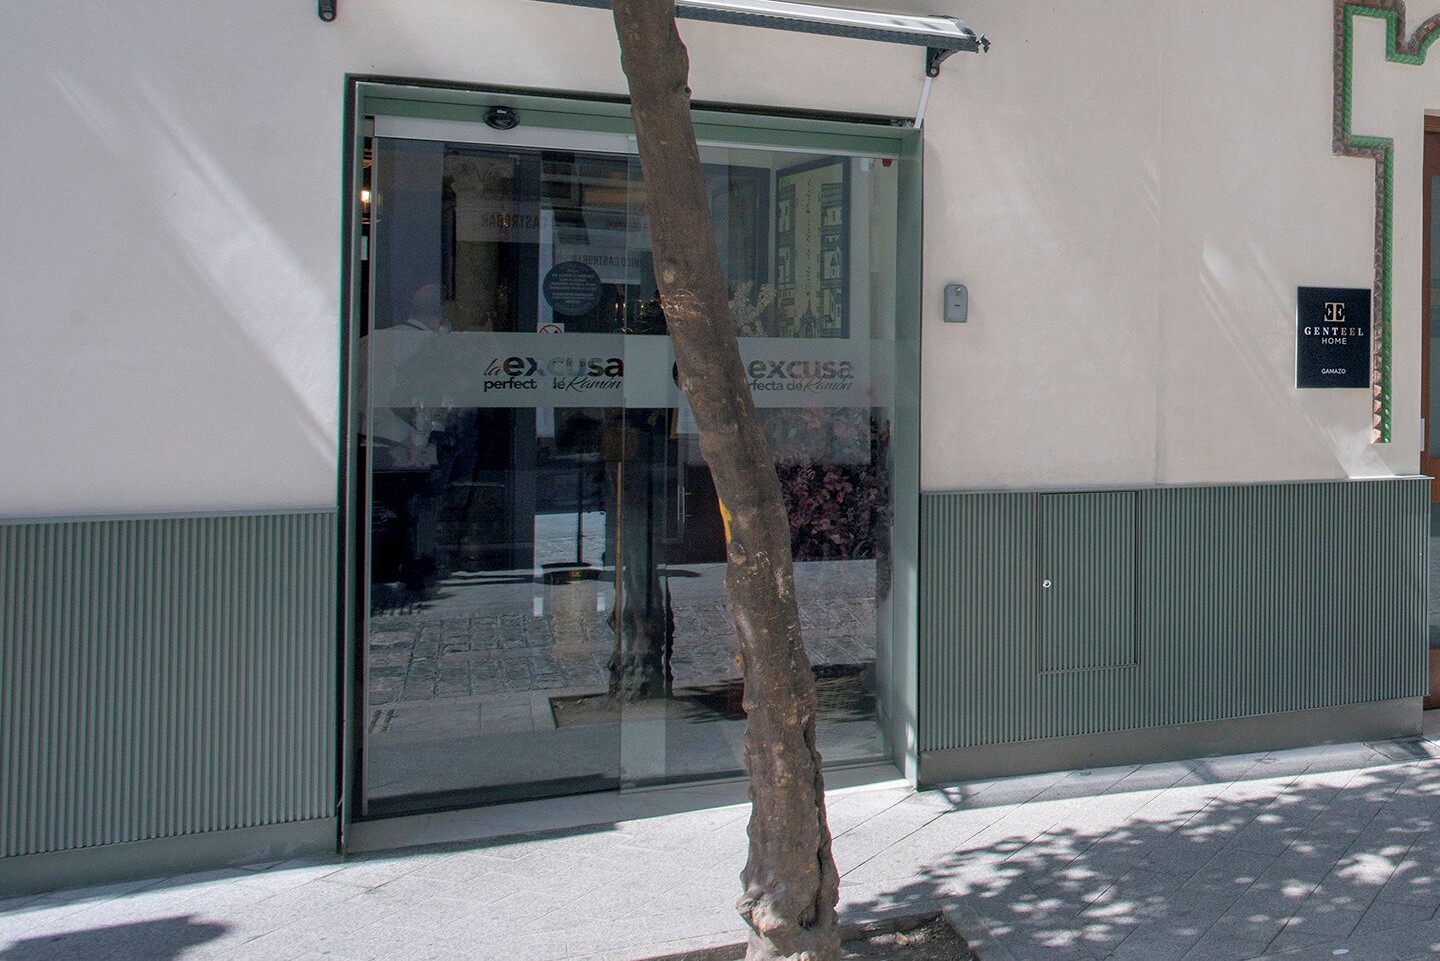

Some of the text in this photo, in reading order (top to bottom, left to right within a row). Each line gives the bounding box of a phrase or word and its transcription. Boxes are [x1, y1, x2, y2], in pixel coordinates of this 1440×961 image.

[1304, 325, 1364, 336] GENTEEL
[1321, 337, 1347, 345] HOME
[502, 355, 625, 378] excusa
[747, 359, 855, 380] excusa
[1321, 367, 1347, 375] GAMAZO
